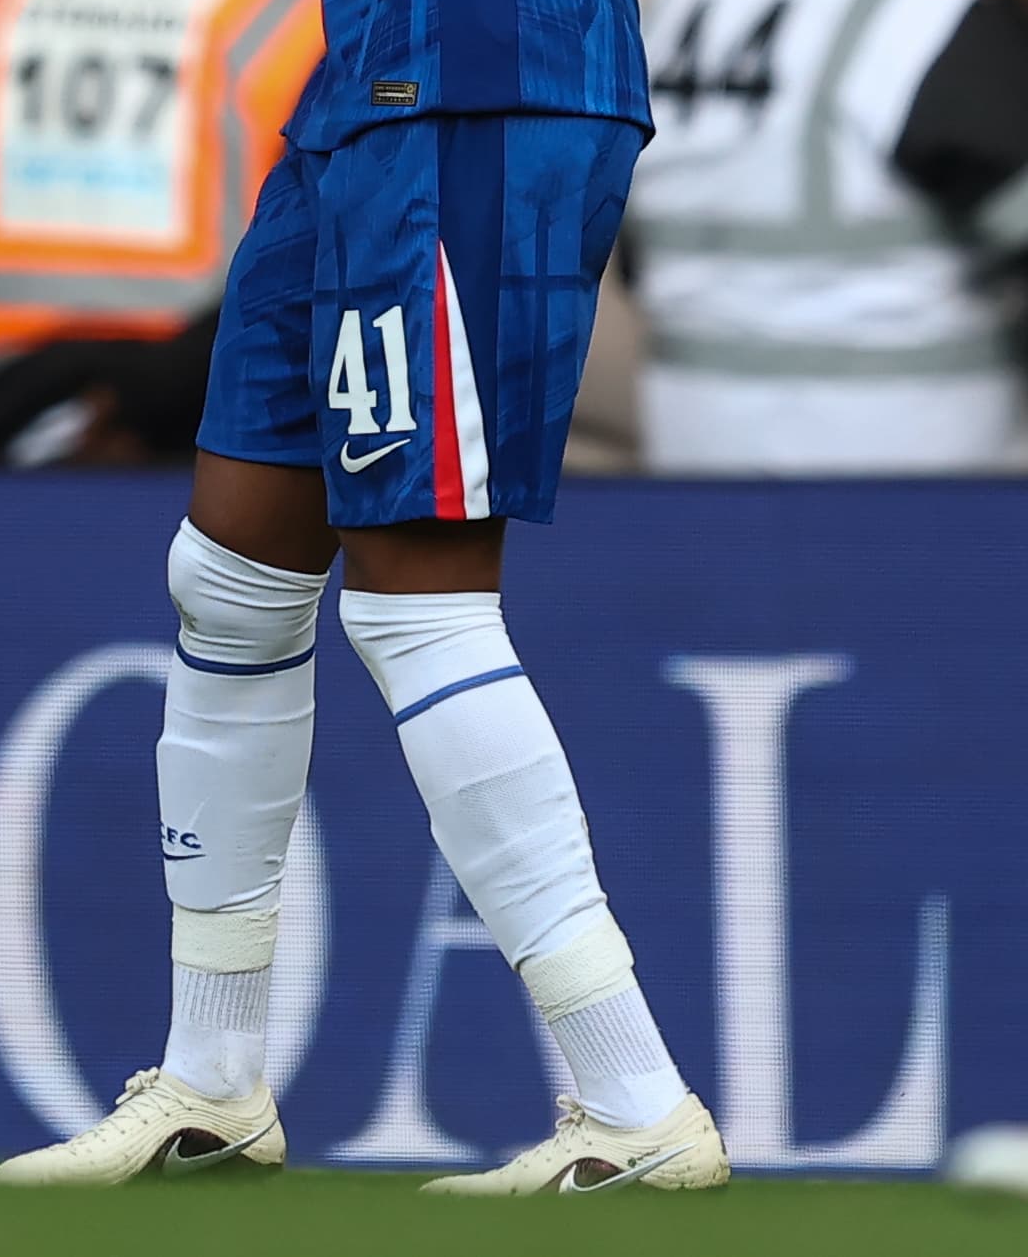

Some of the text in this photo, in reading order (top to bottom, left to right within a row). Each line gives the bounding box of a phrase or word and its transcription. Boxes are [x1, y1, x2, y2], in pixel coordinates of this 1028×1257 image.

[16, 53, 179, 142] 107
[328, 305, 418, 435] 41
[161, 826, 202, 850] FC
